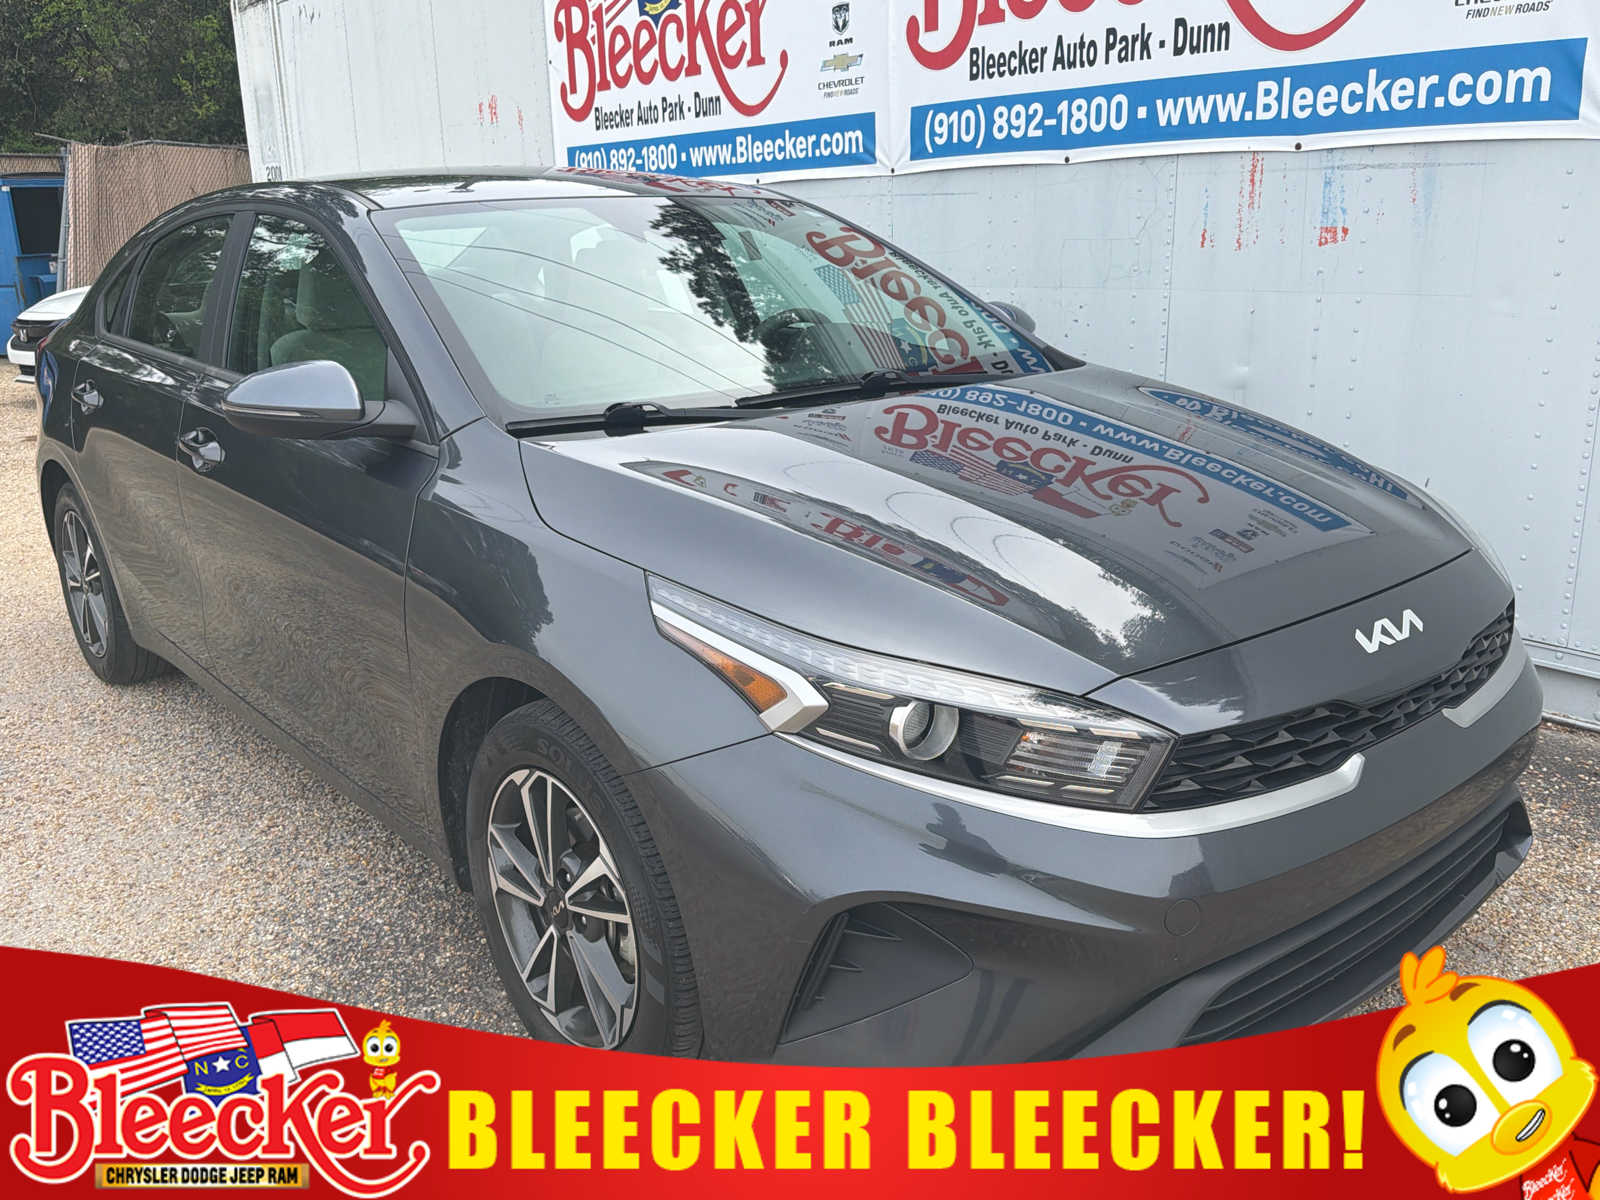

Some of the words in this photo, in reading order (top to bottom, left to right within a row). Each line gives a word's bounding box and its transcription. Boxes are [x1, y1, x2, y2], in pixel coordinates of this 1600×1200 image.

[554, 0, 789, 122] Bleecker
[829, 37, 854, 48] RAM
[969, 40, 1048, 81] Bleecker
[1052, 33, 1097, 71] Auto
[1105, 23, 1152, 65] Park
[1173, 17, 1230, 57] Dunn
[817, 76, 865, 91] CHEVROLET
[594, 102, 634, 131] Bleecker
[637, 102, 659, 125] Auto
[661, 94, 686, 121] Park
[694, 92, 722, 118] Dunn
[924, 104, 986, 153] (910)
[992, 94, 1129, 140] 892-1800
[1156, 66, 1551, 127] www.Bleecker.com
[575, 147, 607, 169] (910)
[610, 143, 678, 172] 892-1800
[689, 129, 864, 168] www.Bleecker.com
[1355, 608, 1424, 653] KIA
